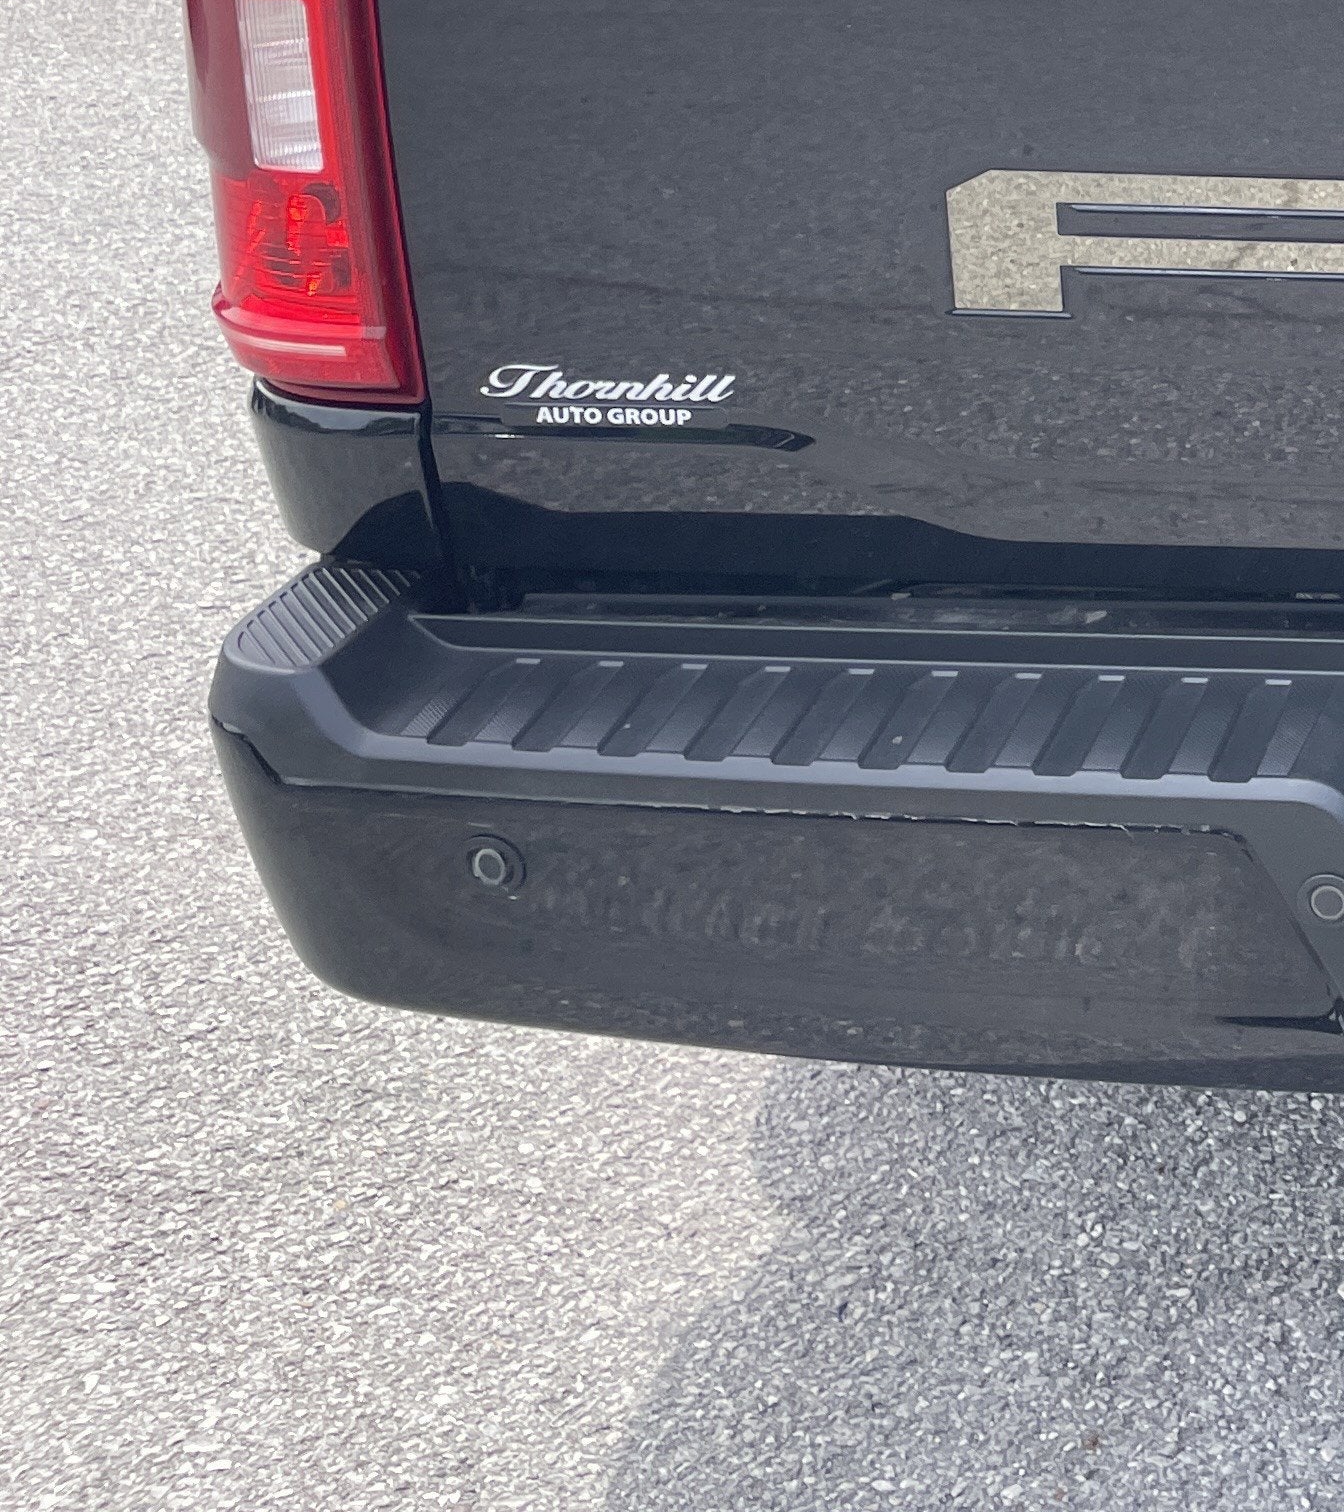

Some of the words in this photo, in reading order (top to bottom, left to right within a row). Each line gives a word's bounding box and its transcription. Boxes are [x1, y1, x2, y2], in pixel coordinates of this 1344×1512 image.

[480, 364, 736, 402] Thornhill
[536, 406, 602, 425] AUTO
[606, 406, 692, 426] GROUP
